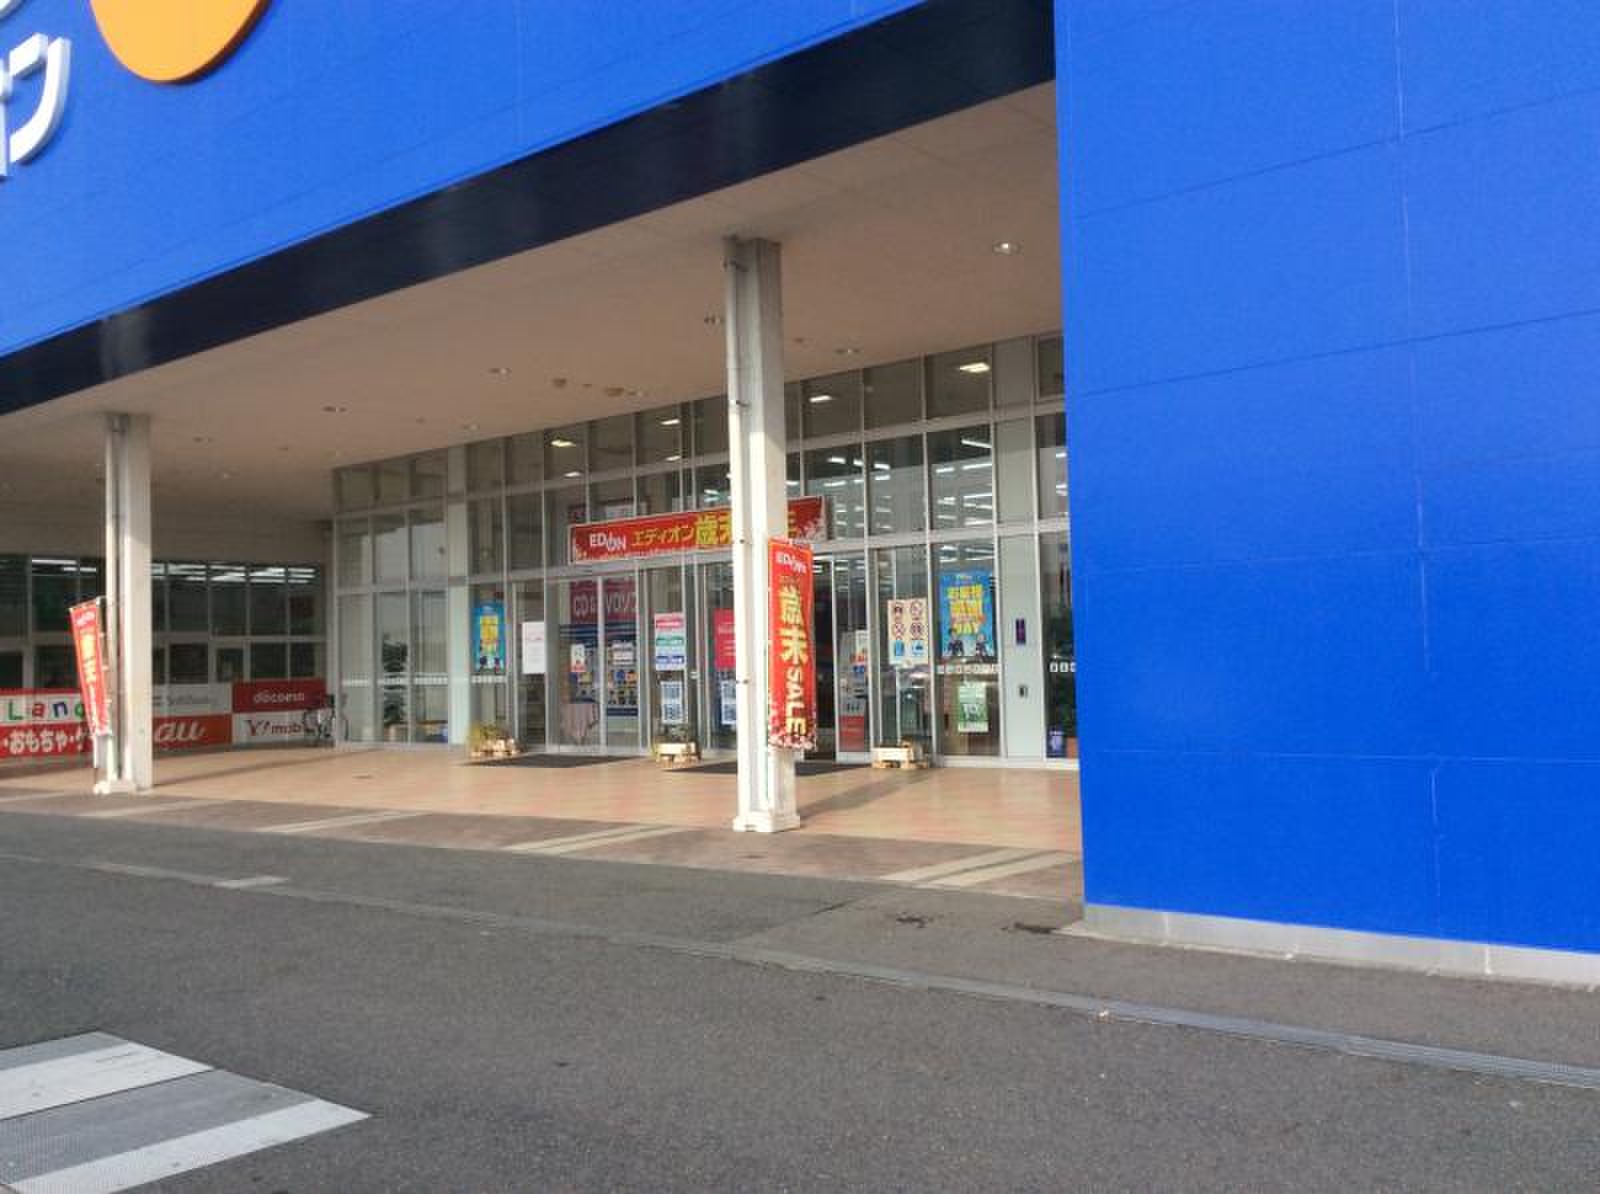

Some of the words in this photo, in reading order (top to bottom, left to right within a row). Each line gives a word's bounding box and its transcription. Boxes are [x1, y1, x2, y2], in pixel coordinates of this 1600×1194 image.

[0, 33, 71, 175] ン
[589, 531, 627, 552] EDION
[253, 688, 305, 704] docomo
[155, 721, 207, 743] au
